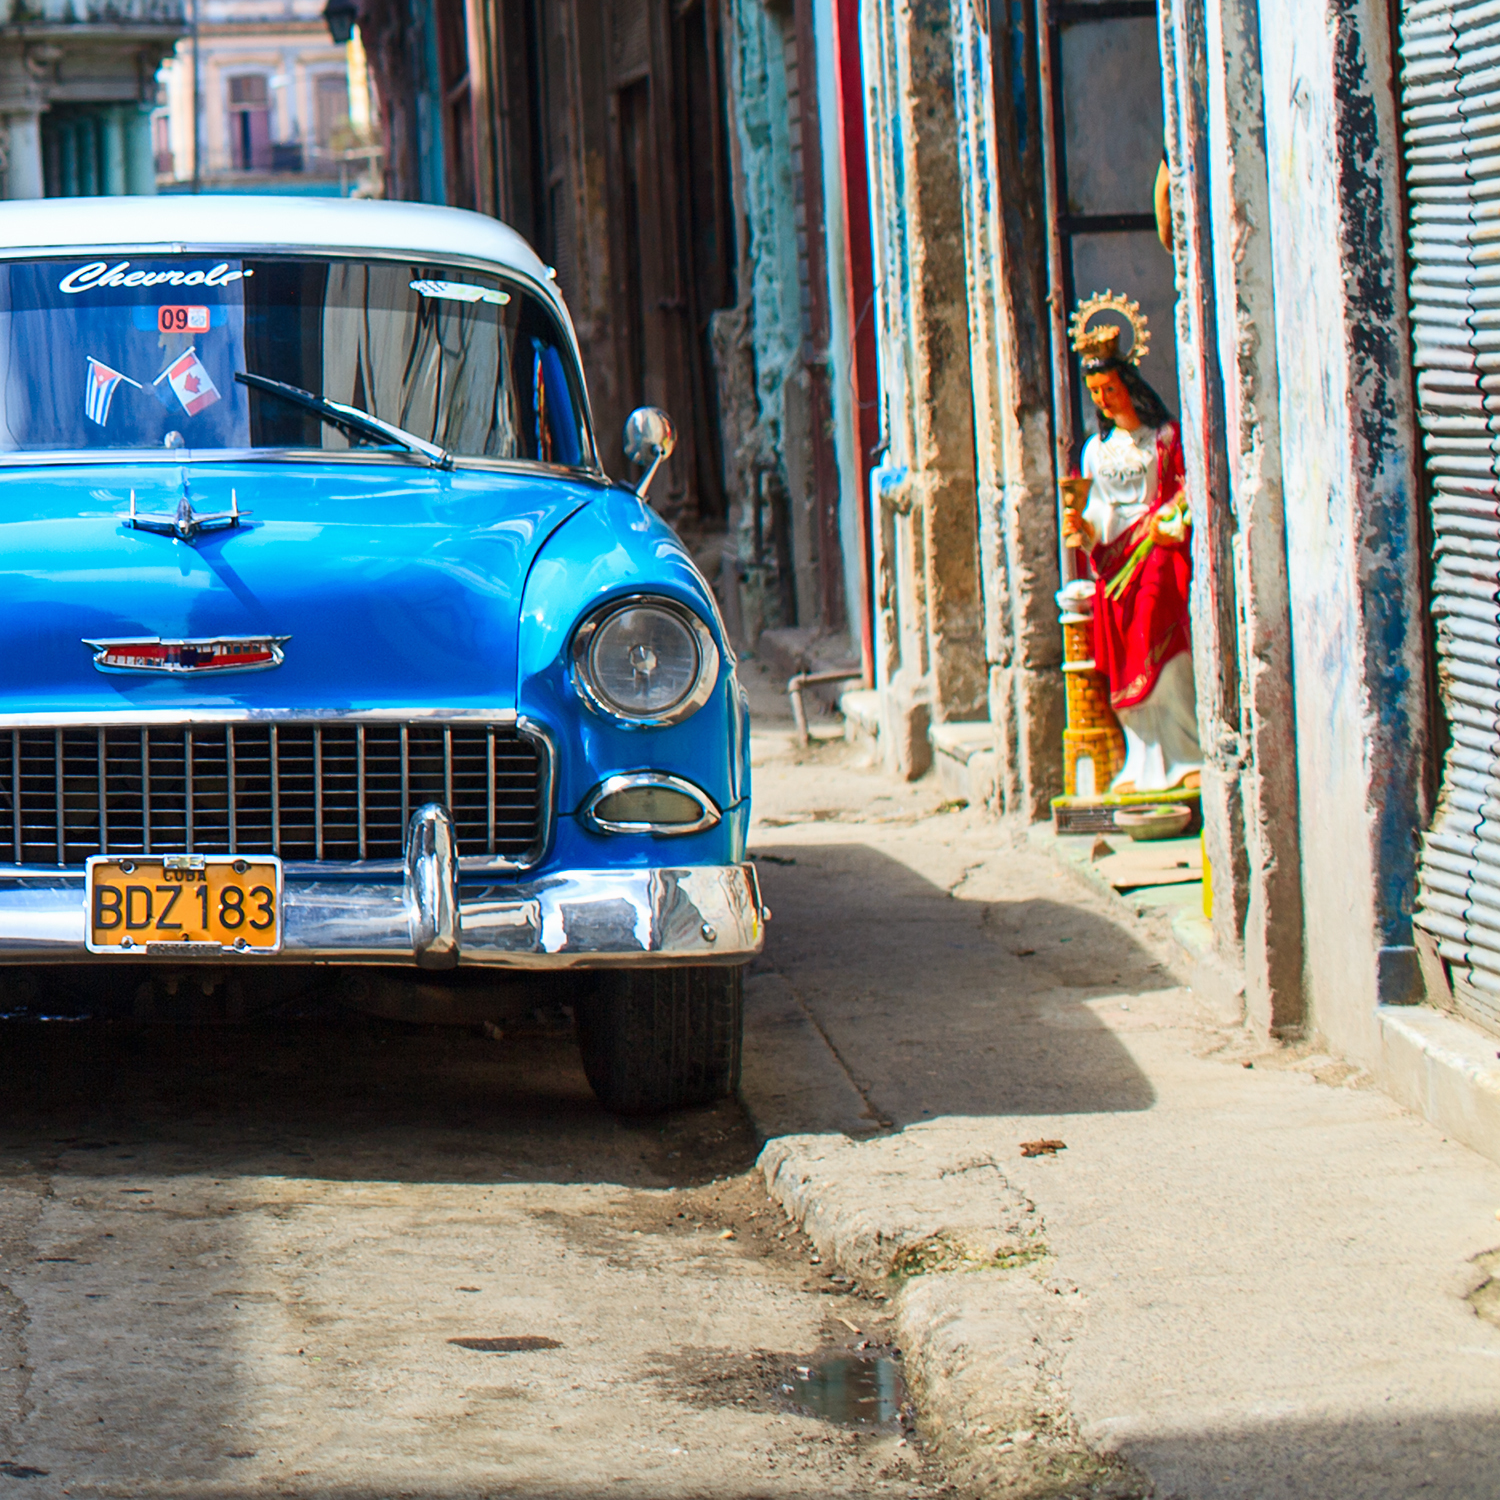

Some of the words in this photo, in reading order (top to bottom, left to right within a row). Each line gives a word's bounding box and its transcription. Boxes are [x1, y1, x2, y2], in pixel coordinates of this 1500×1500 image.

[58, 261, 254, 293] Chevrole
[162, 309, 188, 329] 09
[163, 869, 207, 882] CUBA
[95, 885, 183, 929] BDZ
[195, 885, 274, 929] 183
